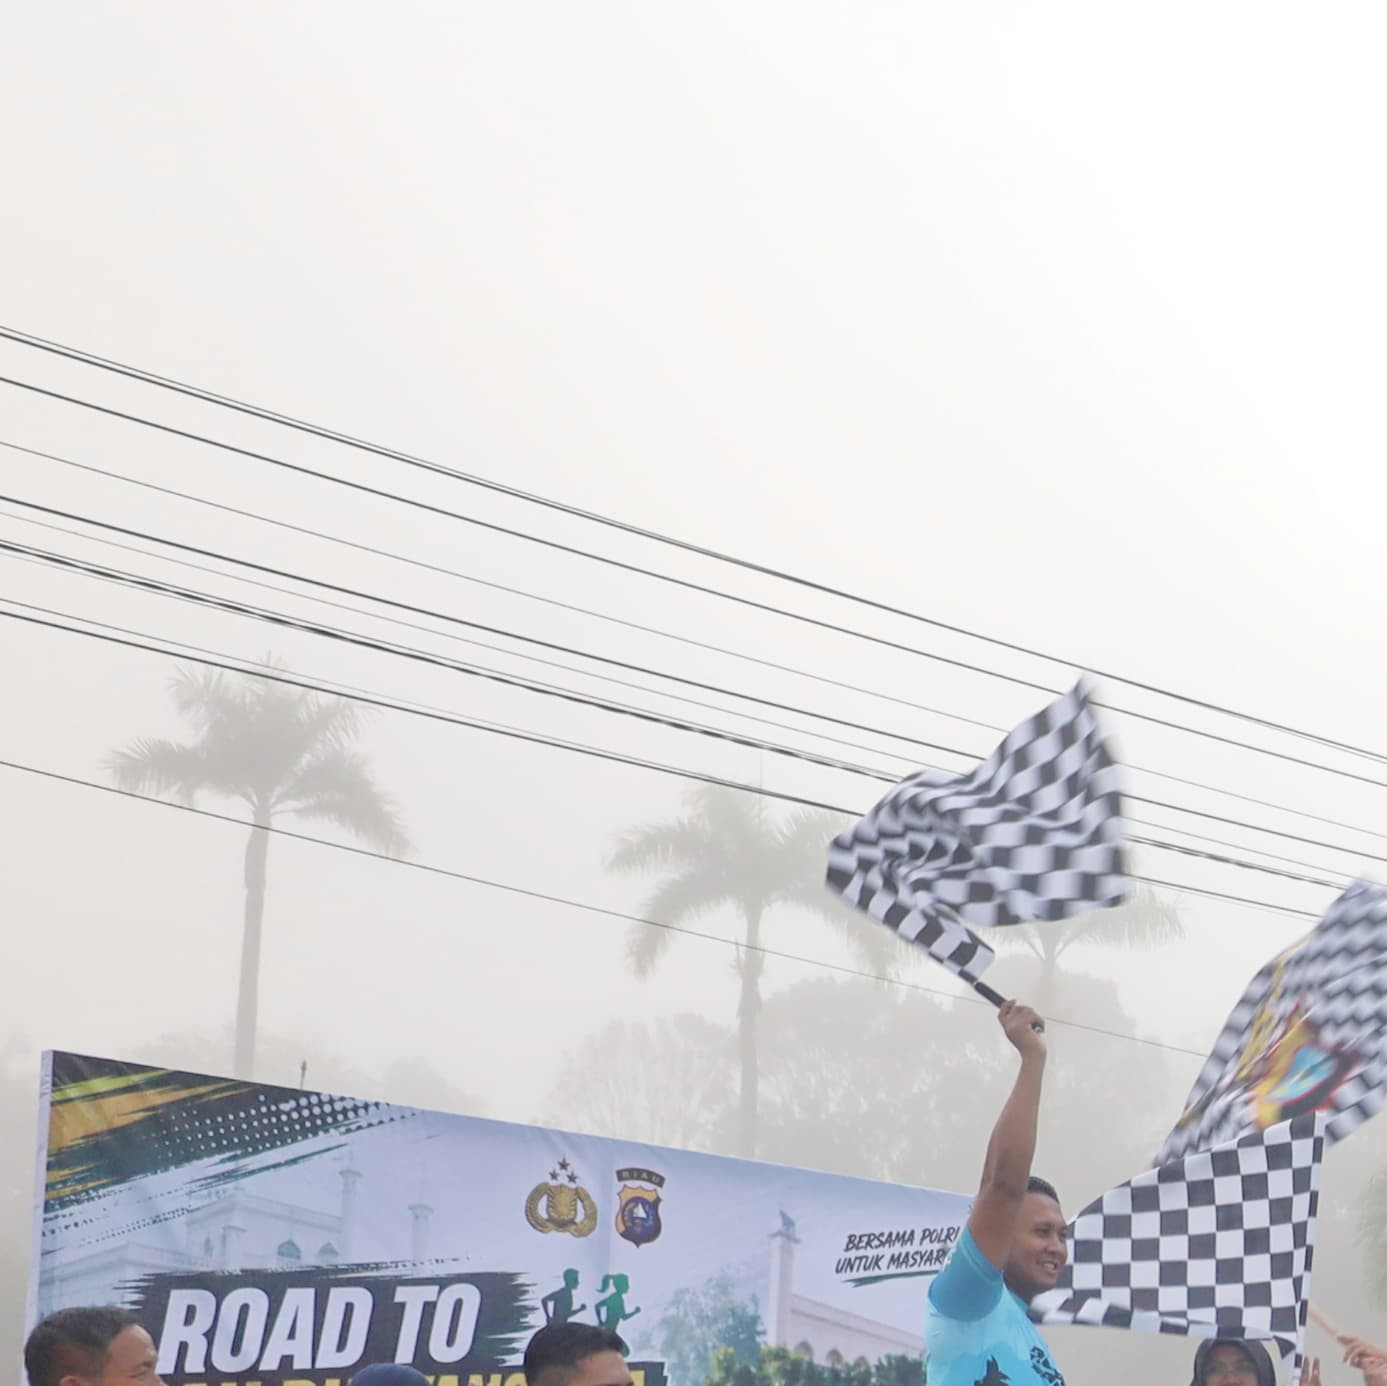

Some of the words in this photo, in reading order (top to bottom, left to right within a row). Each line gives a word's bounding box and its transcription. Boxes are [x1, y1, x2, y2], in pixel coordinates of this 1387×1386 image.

[844, 1229, 915, 1252] BERSAMA
[919, 1226, 961, 1246] POLRI
[835, 1254, 884, 1274] UNTUK
[155, 1287, 373, 1375] ROAD
[393, 1283, 481, 1364] TO
